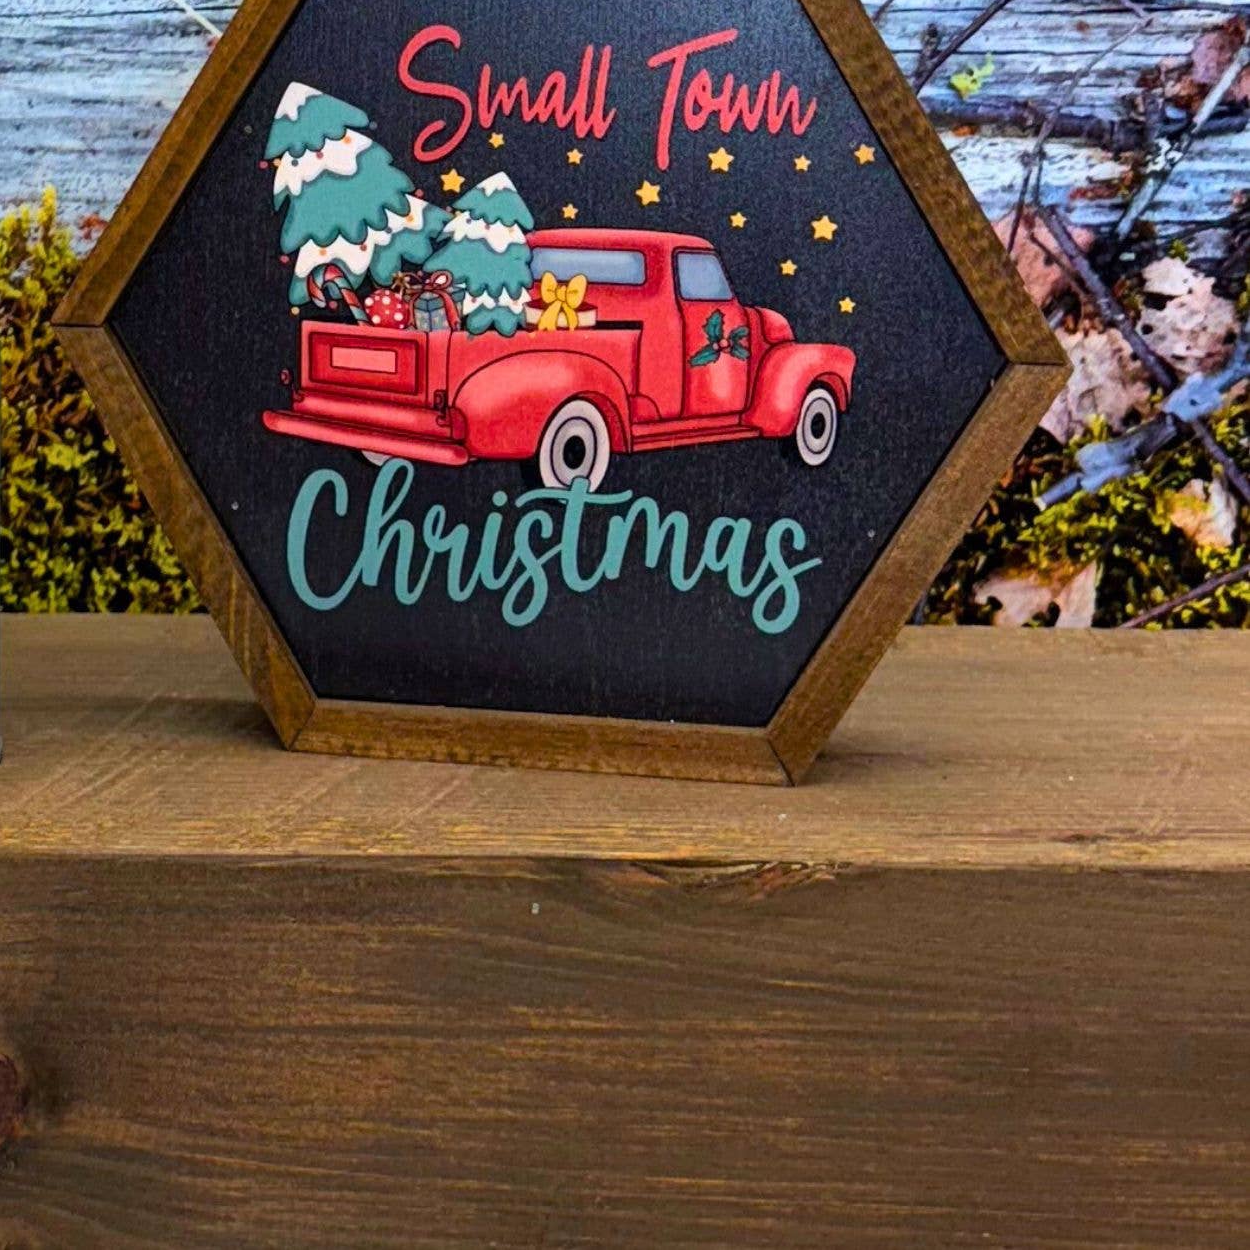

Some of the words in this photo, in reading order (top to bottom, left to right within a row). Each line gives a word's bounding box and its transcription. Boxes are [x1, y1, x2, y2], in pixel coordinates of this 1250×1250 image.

[397, 23, 617, 163] Small
[647, 28, 818, 171] Town
[286, 457, 823, 634] Christmas
